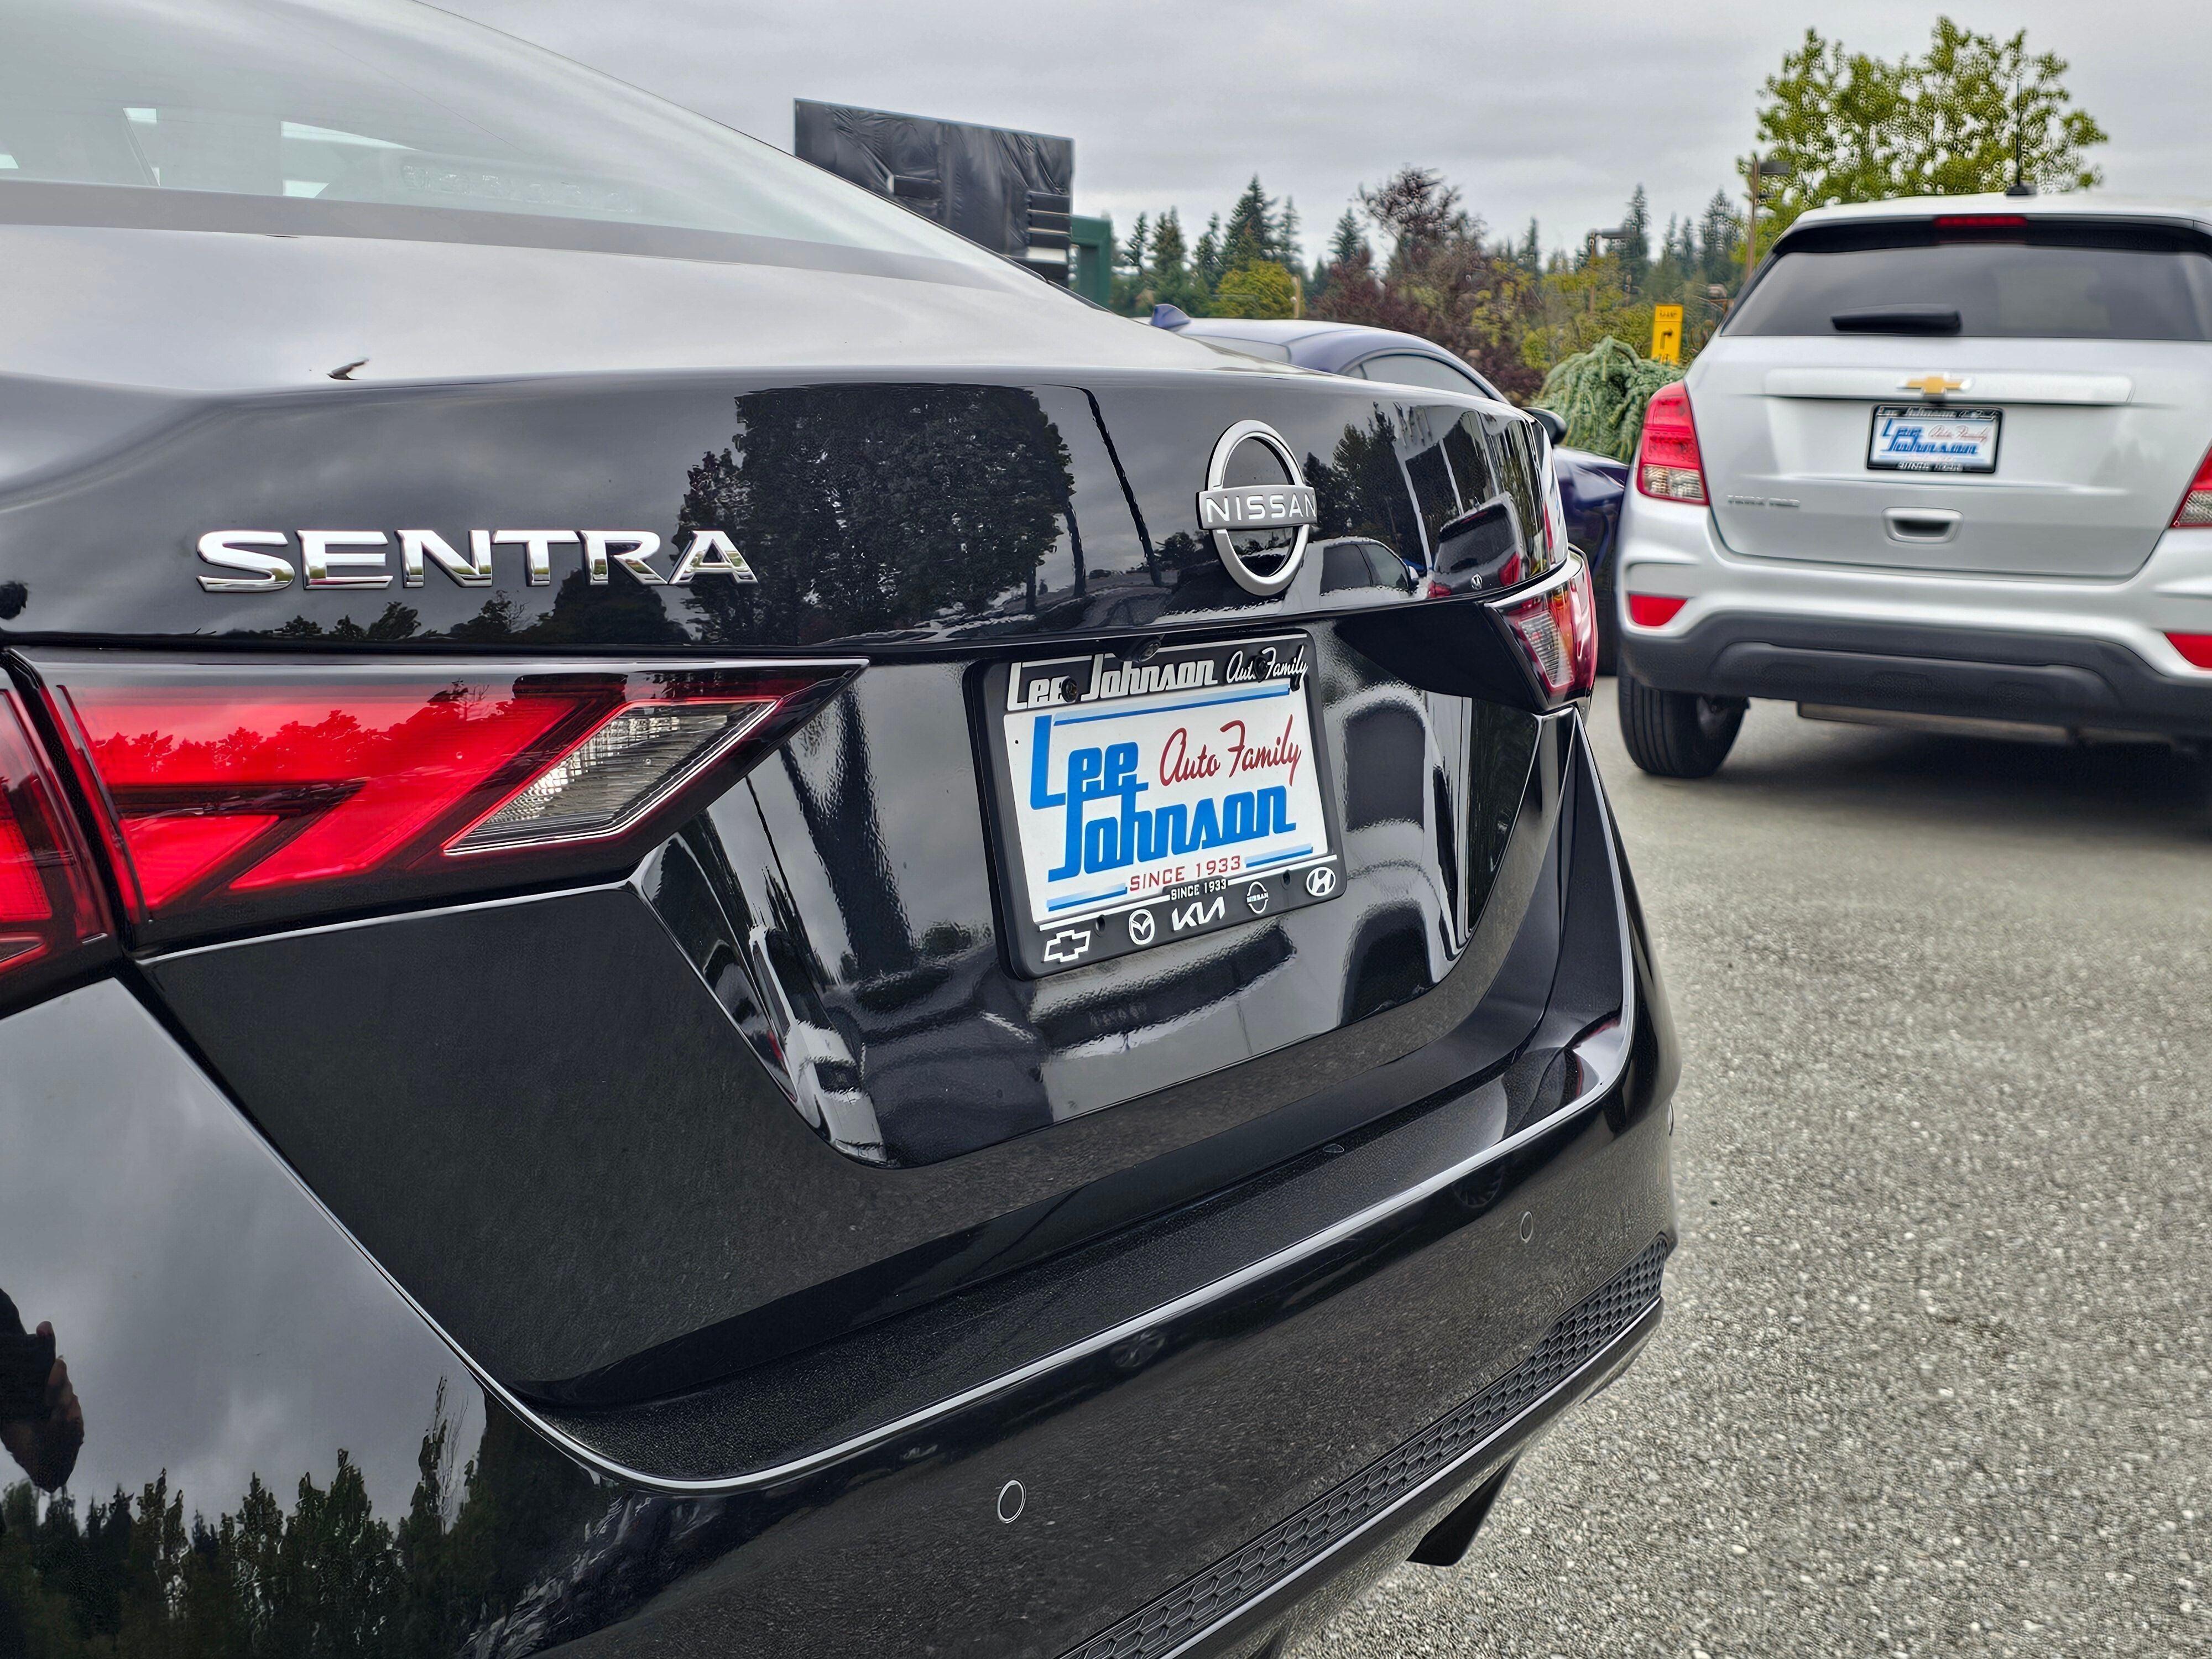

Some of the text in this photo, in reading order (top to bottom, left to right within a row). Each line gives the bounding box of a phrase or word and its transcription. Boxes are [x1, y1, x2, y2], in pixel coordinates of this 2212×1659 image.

[1206, 493, 1316, 523] NISSAN
[196, 529, 760, 592] SENTRA
[1081, 654, 1218, 701] Johnson
[1226, 650, 1257, 684] Aut
[1261, 645, 1308, 687] Family
[1030, 714, 1149, 811] Lee
[1159, 714, 1302, 786] Auto Family
[1048, 774, 1297, 883] Johnson
[1129, 855, 1240, 891] SINCE 1933
[1171, 878, 1227, 900] SINCE 1933
[1171, 896, 1225, 931] KIA
